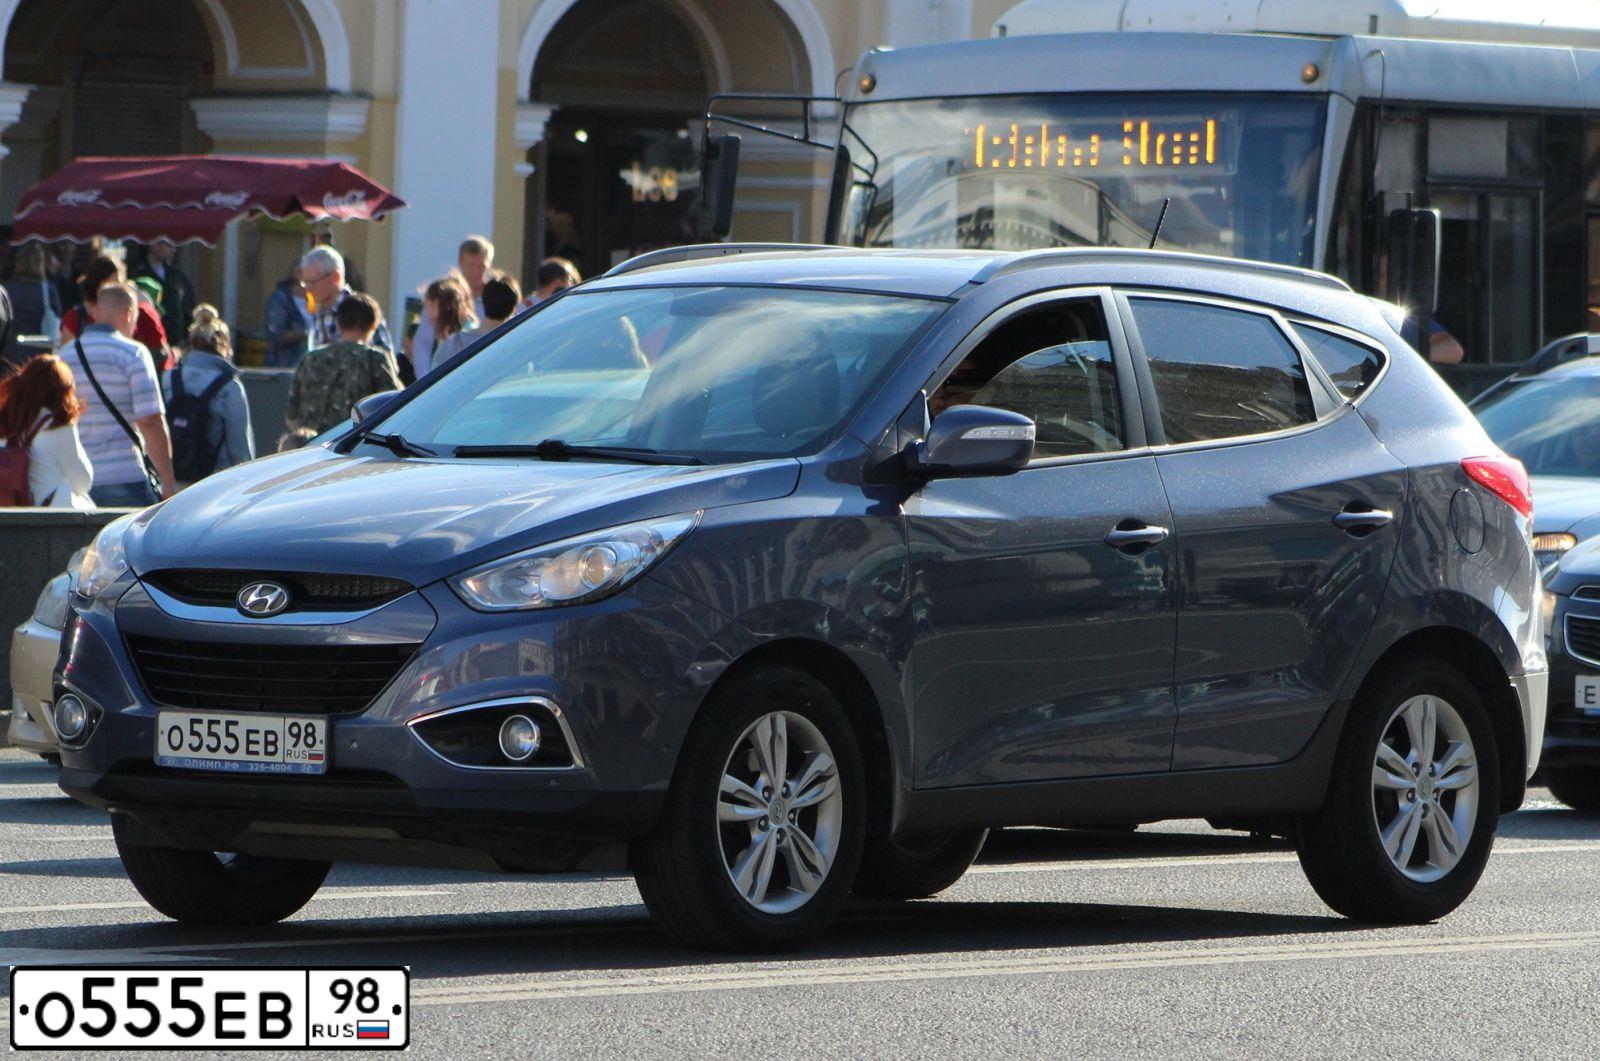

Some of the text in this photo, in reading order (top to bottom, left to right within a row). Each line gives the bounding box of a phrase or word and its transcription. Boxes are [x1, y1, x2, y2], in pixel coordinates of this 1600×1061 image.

[288, 721, 317, 749] 98
[286, 749, 307, 760] RUS
[184, 759, 240, 770] ОЛИМП.РФ
